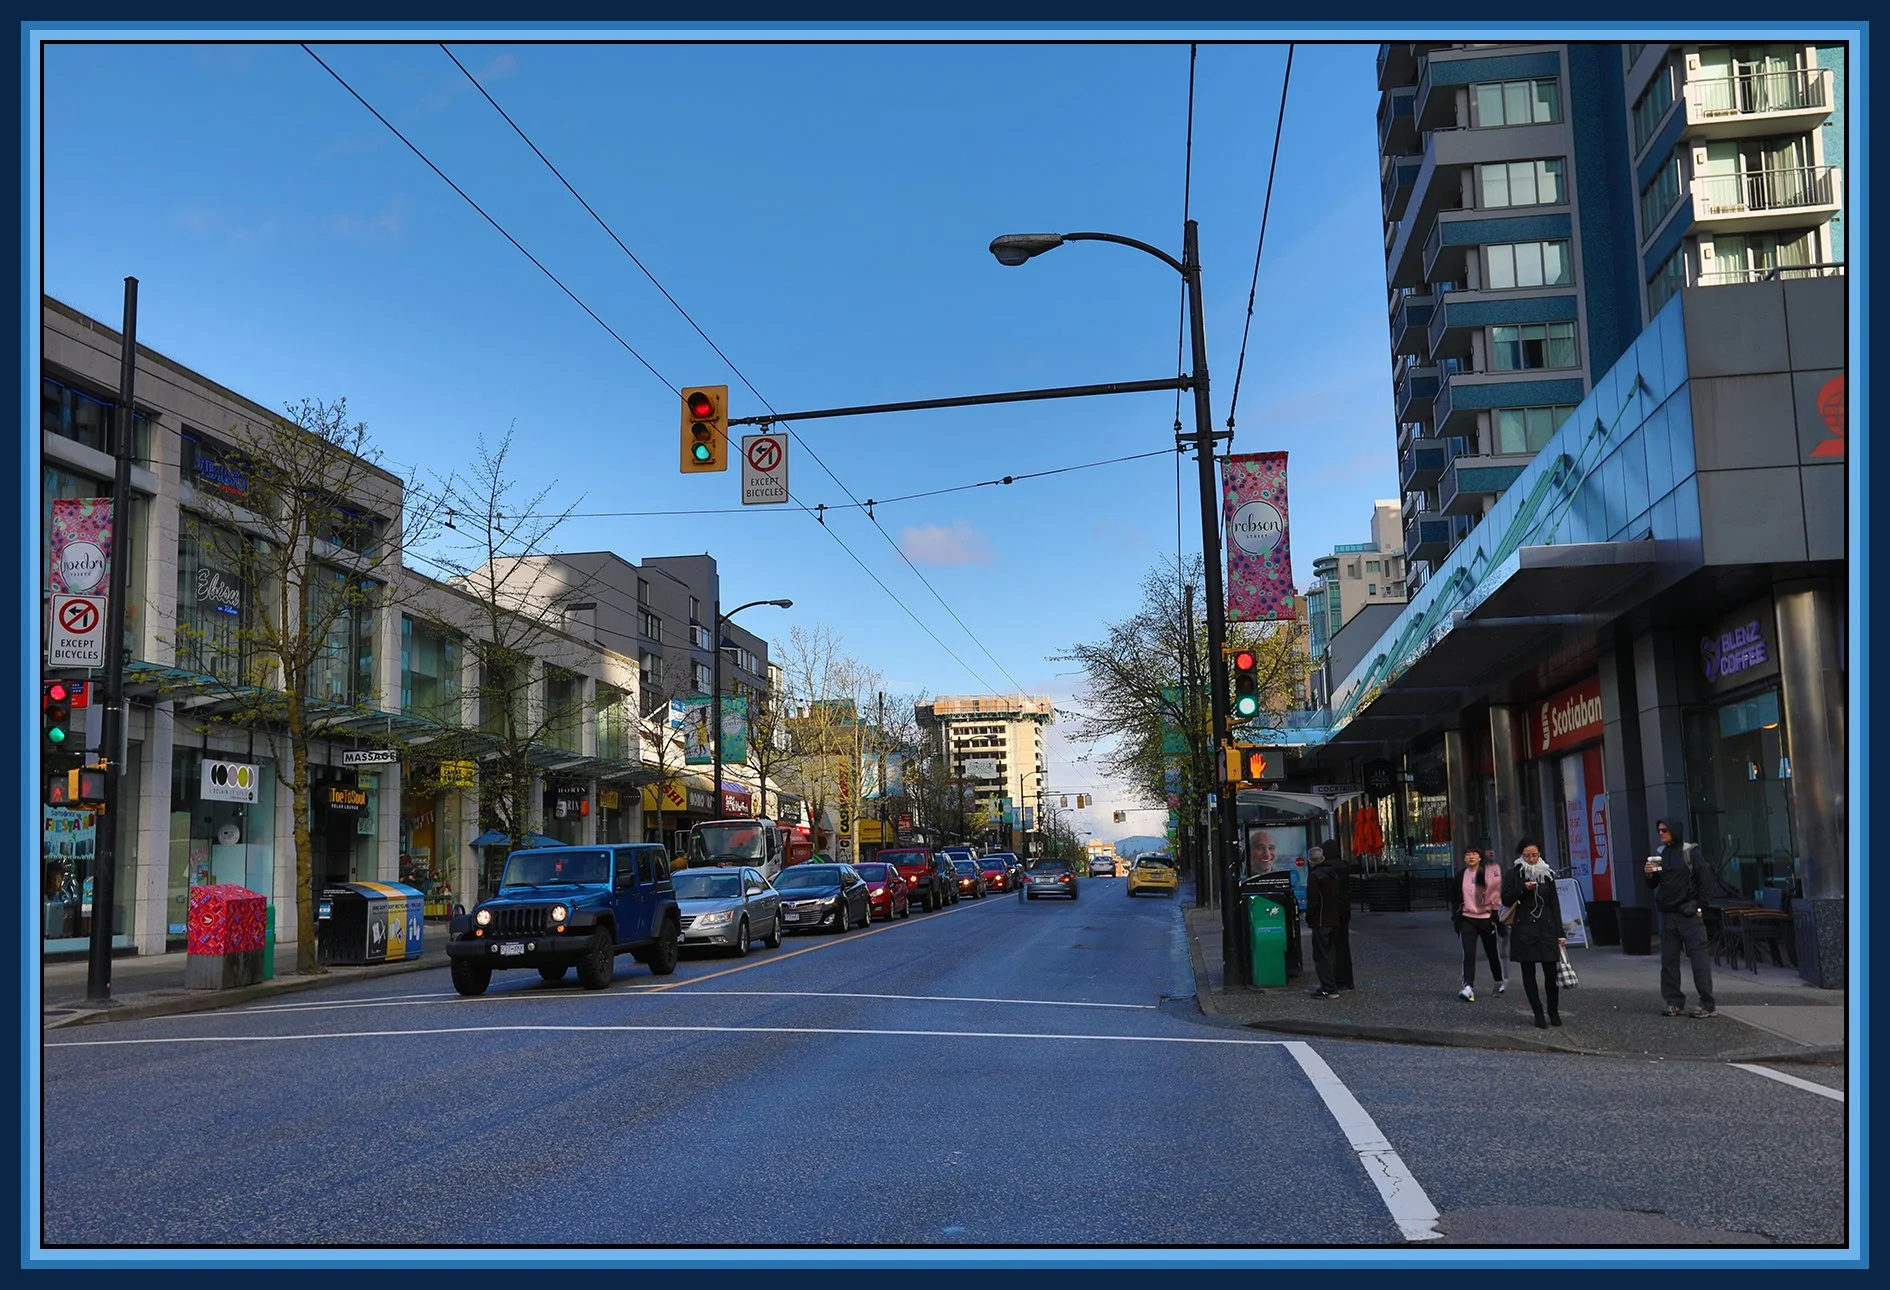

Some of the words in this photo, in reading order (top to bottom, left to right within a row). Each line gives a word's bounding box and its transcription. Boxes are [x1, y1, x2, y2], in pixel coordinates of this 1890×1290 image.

[750, 477, 779, 487] EXCEPT
[746, 487, 784, 497] BICYCLES
[1234, 513, 1281, 533] robson
[1721, 621, 1761, 653] BLENZ
[60, 639, 94, 648] EXCEPT
[55, 650, 98, 660] BICYCLES
[1720, 642, 1768, 676] COFFEE
[1551, 694, 1602, 737] Scotiaban
[345, 752, 398, 762] MASSAGE
[45, 818, 81, 833] FIESTA
